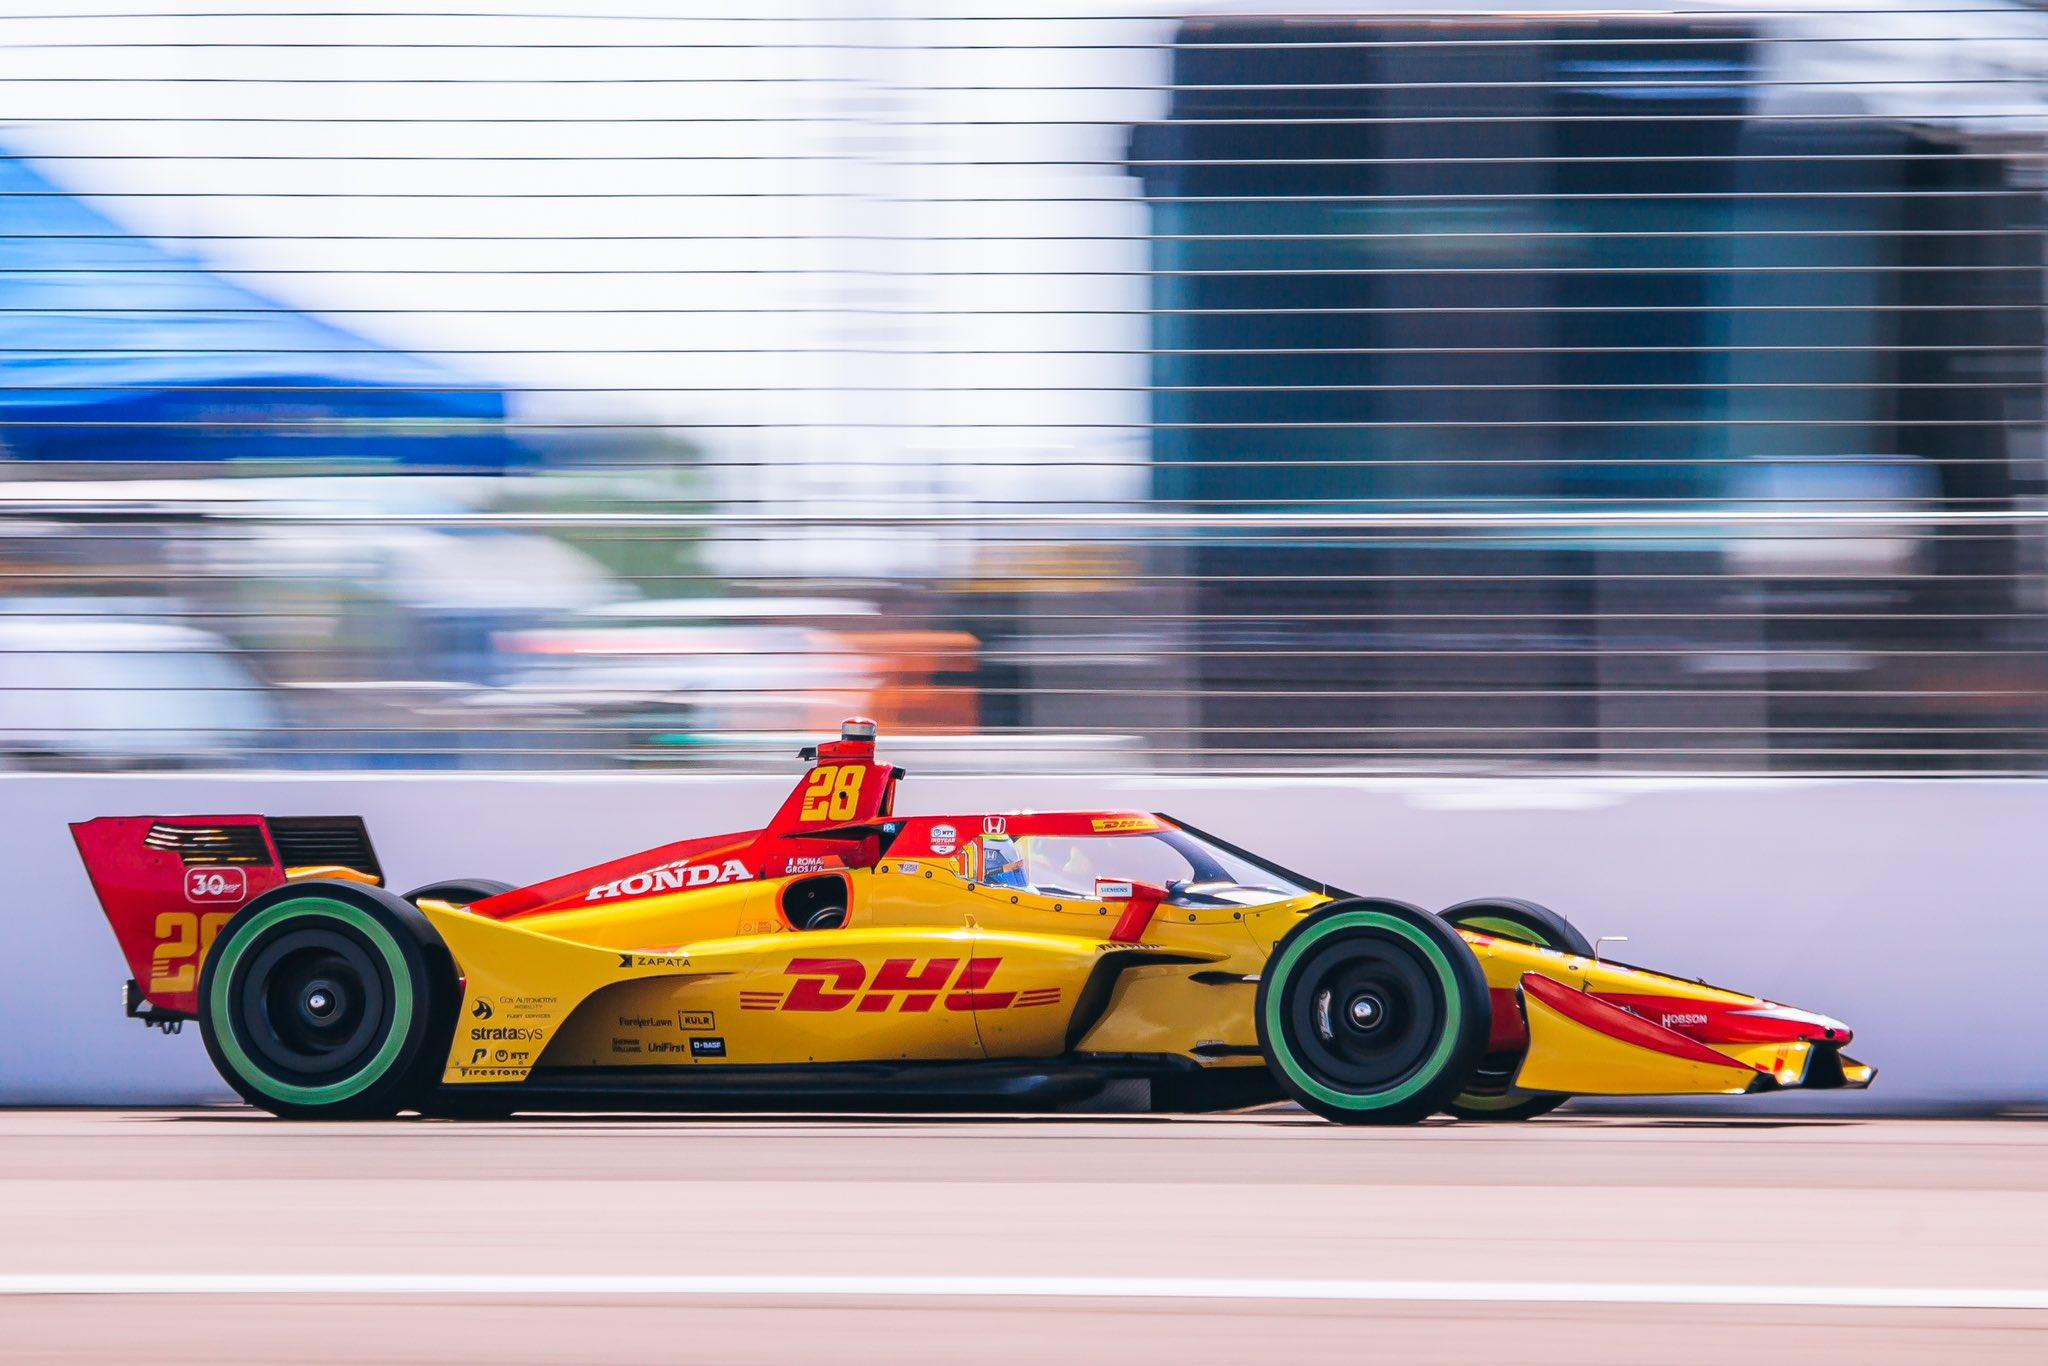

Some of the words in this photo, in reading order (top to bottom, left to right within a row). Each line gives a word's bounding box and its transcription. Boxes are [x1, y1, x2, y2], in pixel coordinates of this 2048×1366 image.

[801, 765, 866, 821] 28
[796, 857, 824, 866] ROMA
[784, 864, 824, 874] GROSJEA
[191, 874, 225, 895] 30
[585, 859, 754, 901] HONDA
[637, 956, 691, 967] ZAPATA
[780, 957, 1019, 1013] DHL
[685, 1016, 710, 1025] KULR
[1662, 1014, 1708, 1028] HOBSON
[471, 1027, 543, 1043] stratasys
[648, 1043, 685, 1053] UniFirst
[703, 1041, 721, 1049] BASF
[510, 1051, 530, 1060] NTT
[461, 1067, 528, 1077] Firestone
